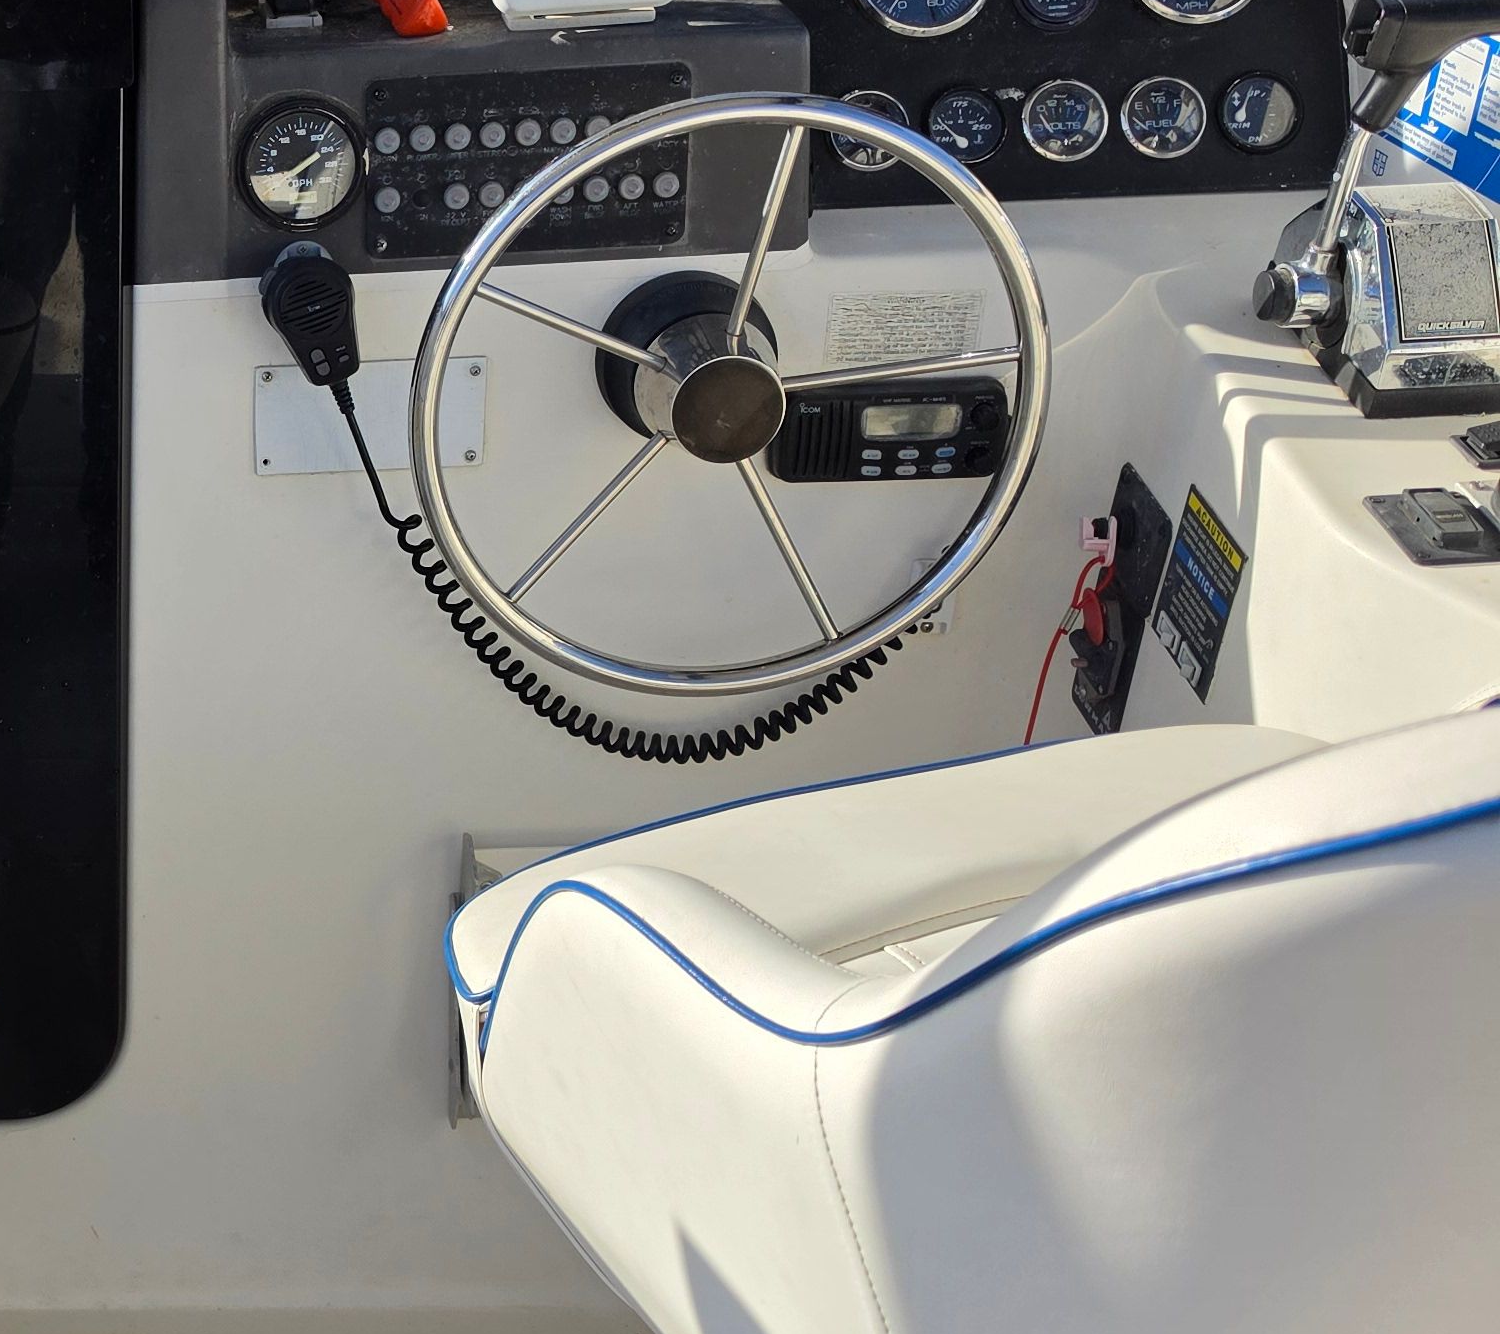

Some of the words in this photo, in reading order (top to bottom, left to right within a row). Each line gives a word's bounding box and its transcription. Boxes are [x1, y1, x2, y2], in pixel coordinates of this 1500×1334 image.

[898, 1, 908, 9] 0
[1176, 1, 1209, 11] MPH
[1045, 99, 1058, 107] 12
[1134, 102, 1143, 110] E
[1150, 96, 1167, 104] 1/2
[1173, 99, 1181, 108] F
[1145, 119, 1177, 128] FUEL
[1417, 320, 1485, 332] QUICKSILVER
[1200, 513, 1235, 562] CAUTION
[1186, 555, 1215, 601] NOTICE
